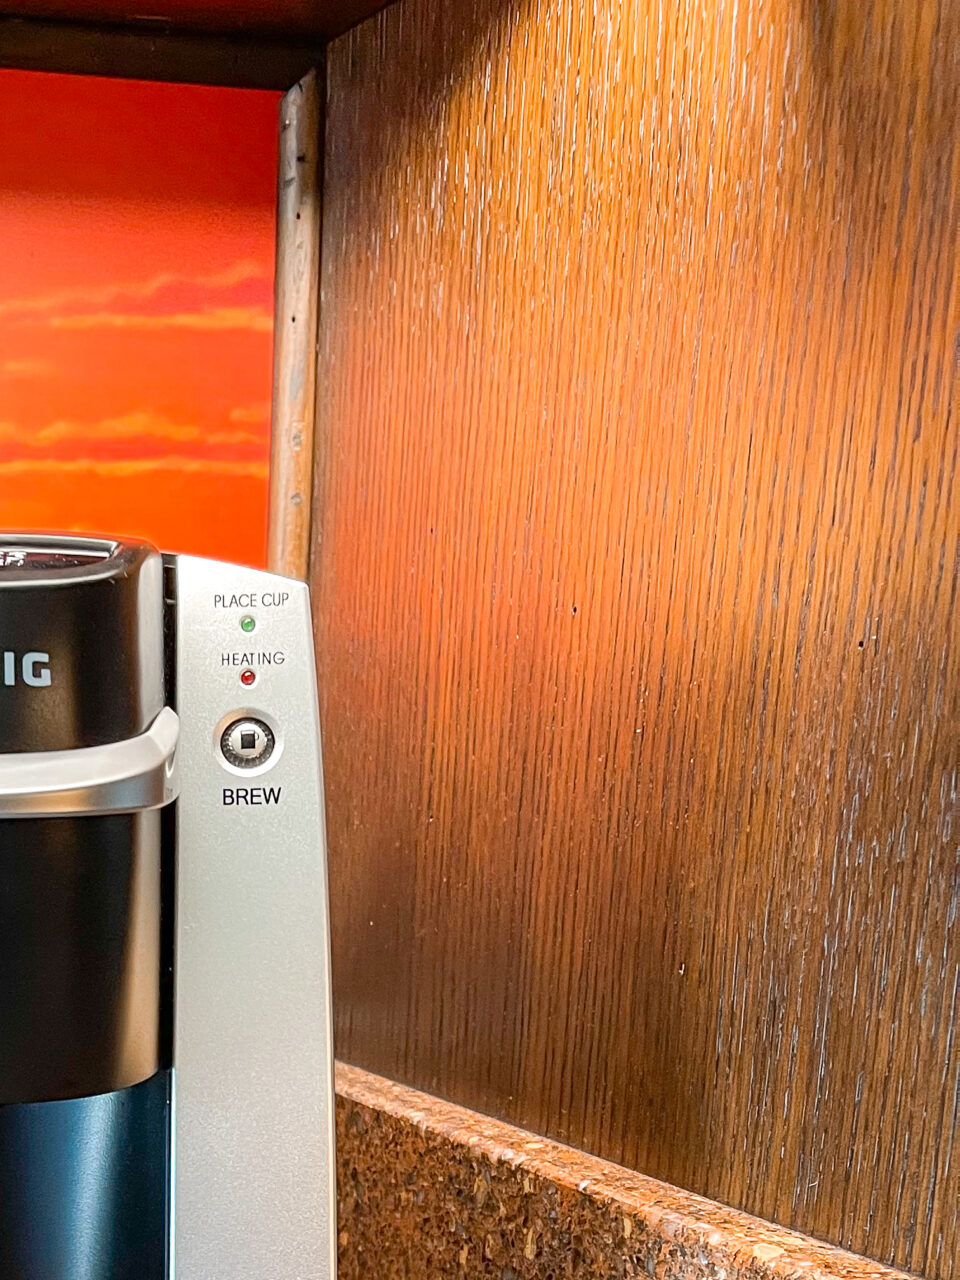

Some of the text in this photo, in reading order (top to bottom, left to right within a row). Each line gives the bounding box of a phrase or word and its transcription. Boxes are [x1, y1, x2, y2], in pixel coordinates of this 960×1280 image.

[214, 592, 290, 609] PLACE CUP
[221, 651, 286, 667] HEATING
[222, 786, 282, 806] BREW
